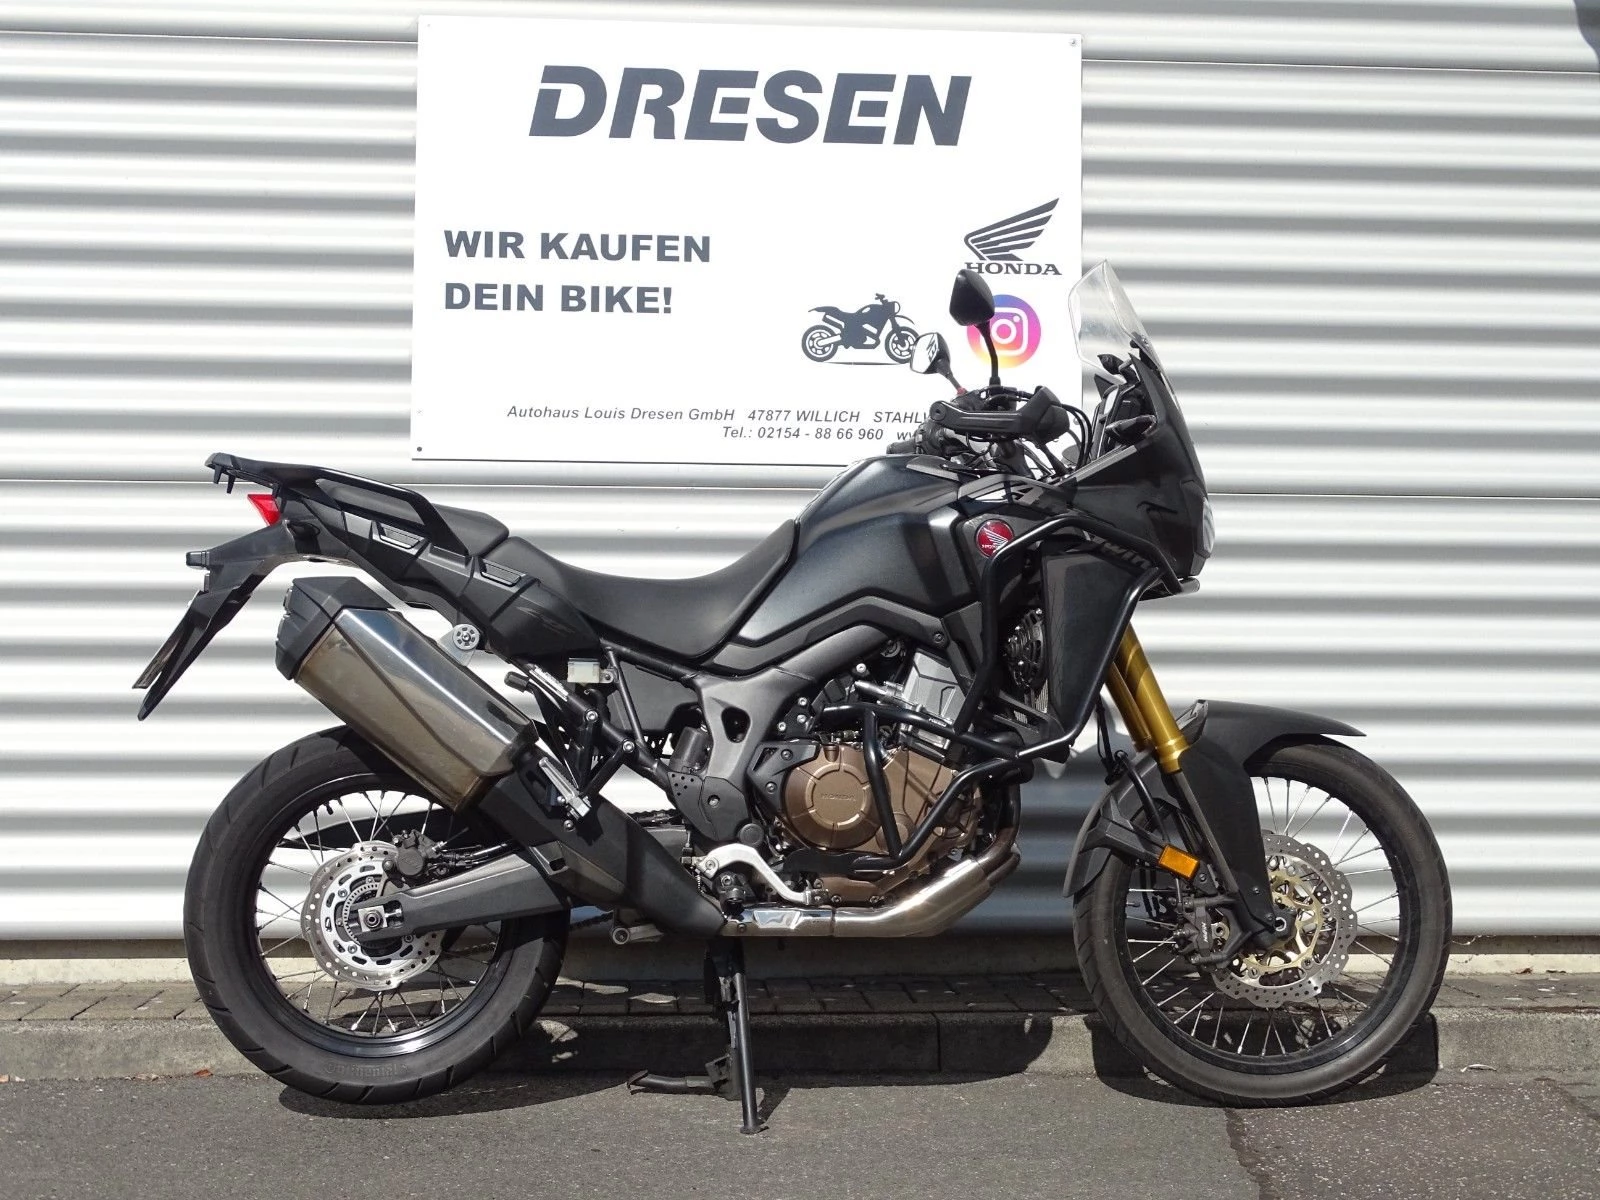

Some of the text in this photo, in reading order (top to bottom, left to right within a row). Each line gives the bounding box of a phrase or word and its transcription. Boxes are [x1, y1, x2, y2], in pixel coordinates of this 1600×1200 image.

[529, 65, 972, 146] DRESEN
[444, 230, 711, 262] WIR KAUFEN
[964, 262, 1063, 276] HONDA
[445, 283, 672, 314] DEIN BIKE!
[507, 405, 928, 423] Autohaus Louis Dresen GmbH 47877 WILLICH STAHL
[723, 426, 752, 438] Tel.:
[758, 427, 801, 439] 02154
[815, 428, 832, 440] 88
[837, 428, 853, 440] 66
[858, 429, 884, 441] 960
